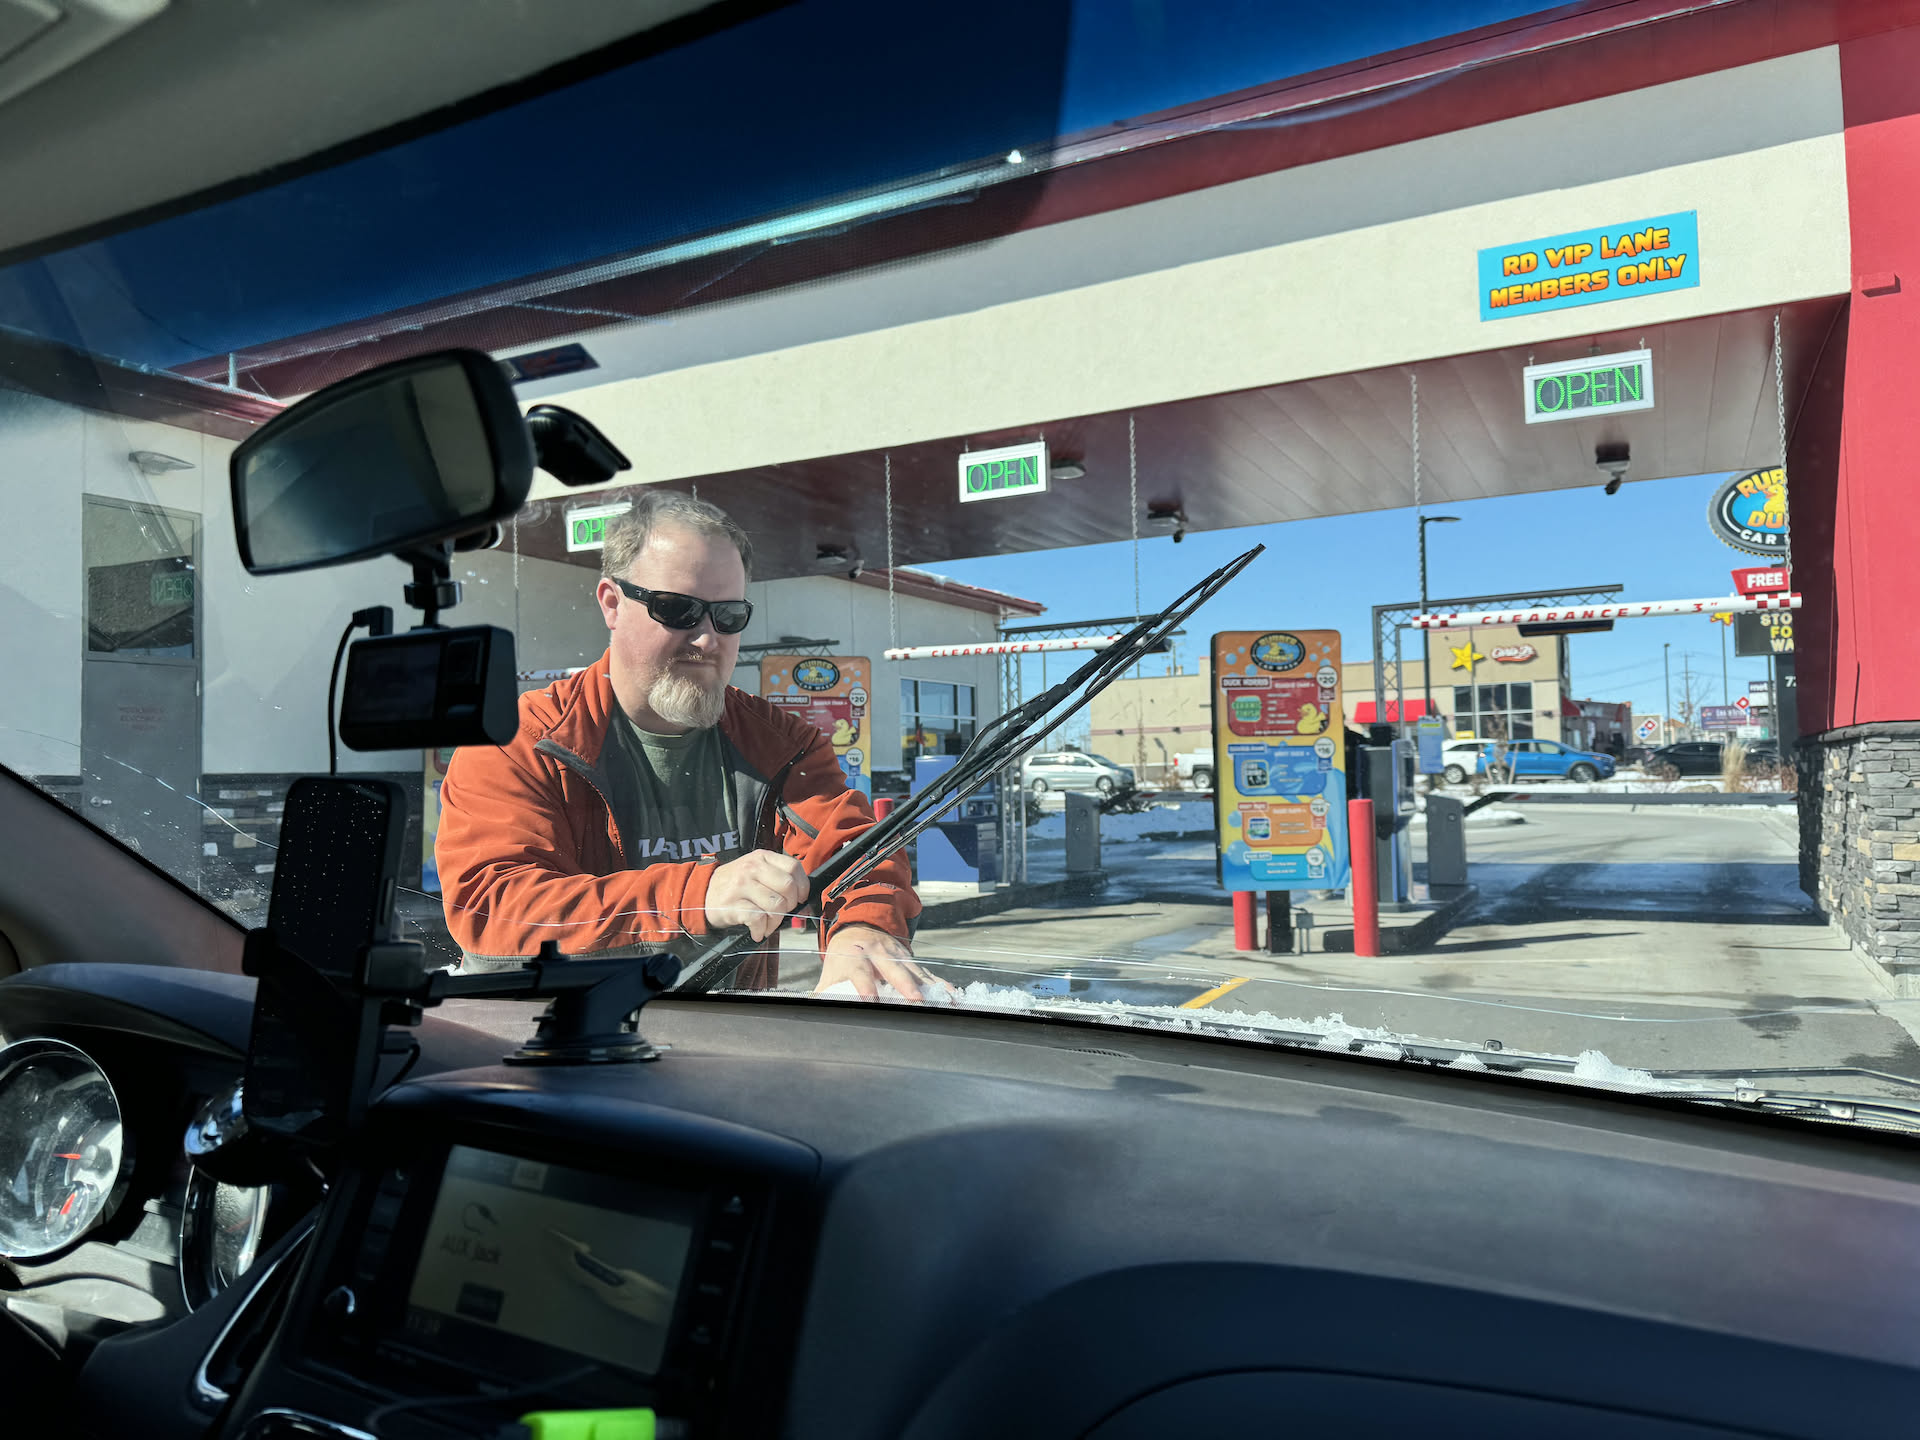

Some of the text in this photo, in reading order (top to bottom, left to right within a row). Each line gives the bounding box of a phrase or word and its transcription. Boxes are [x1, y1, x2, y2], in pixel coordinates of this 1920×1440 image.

[1503, 227, 1670, 276] RD VIP LANE
[1490, 253, 1687, 309] MEMBERS ONLY
[1535, 364, 1641, 413] OPEN
[967, 455, 1038, 493] OPEN
[1740, 529, 1777, 545] CAR
[1746, 572, 1784, 589] FREE
[1481, 607, 1629, 625] CLEARANCE
[1760, 612, 1793, 627] STO
[1769, 625, 1793, 639] FO
[931, 643, 1030, 658] CLEARANCE
